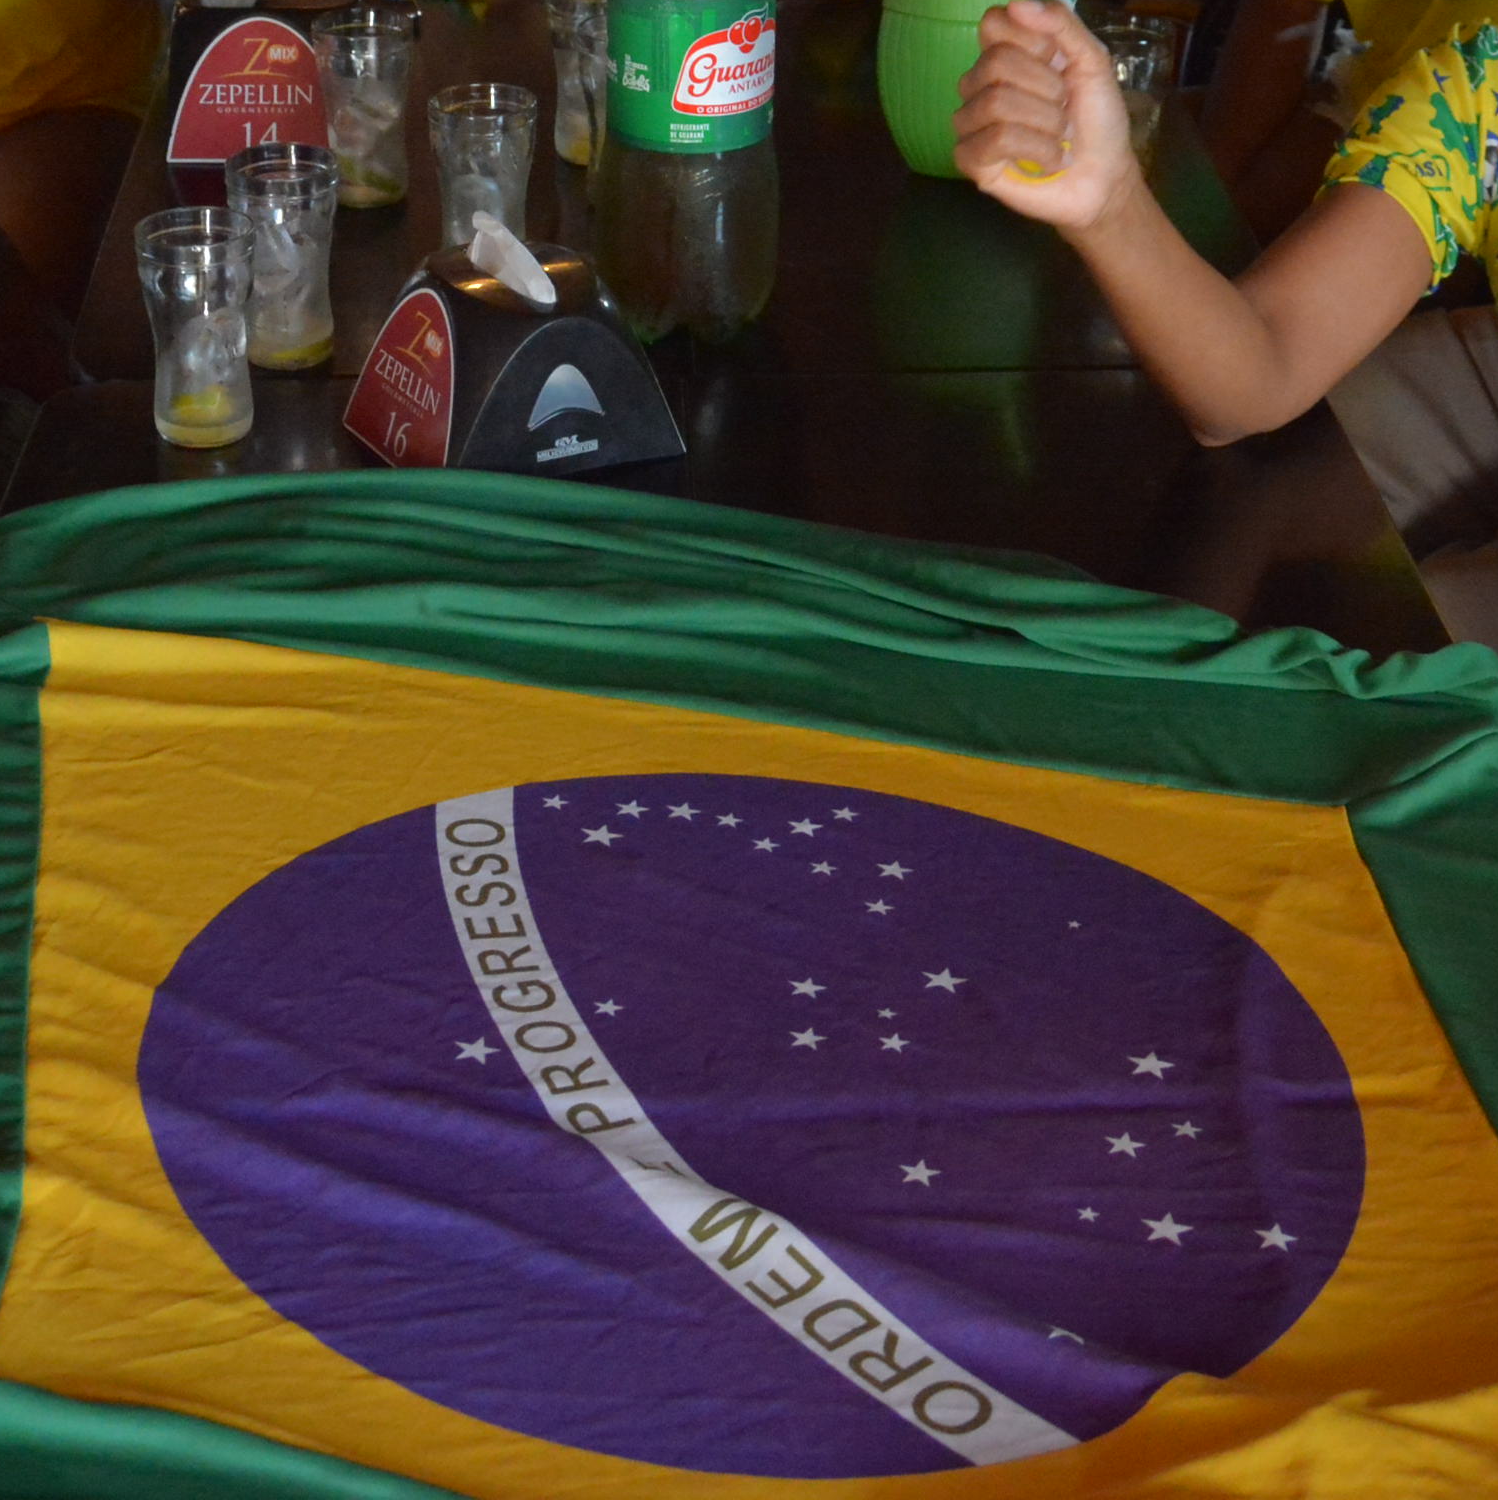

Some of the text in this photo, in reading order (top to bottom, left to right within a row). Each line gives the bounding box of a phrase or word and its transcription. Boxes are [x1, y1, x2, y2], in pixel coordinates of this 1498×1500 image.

[268, 47, 297, 61] MIX
[687, 52, 775, 98] Guaran
[198, 83, 314, 105] ZEPELLIN
[242, 121, 279, 148] 14
[374, 349, 441, 416] ZEPELLIN
[383, 411, 412, 458] 16
[444, 818, 993, 1435] ORDEM PROGRESSO
